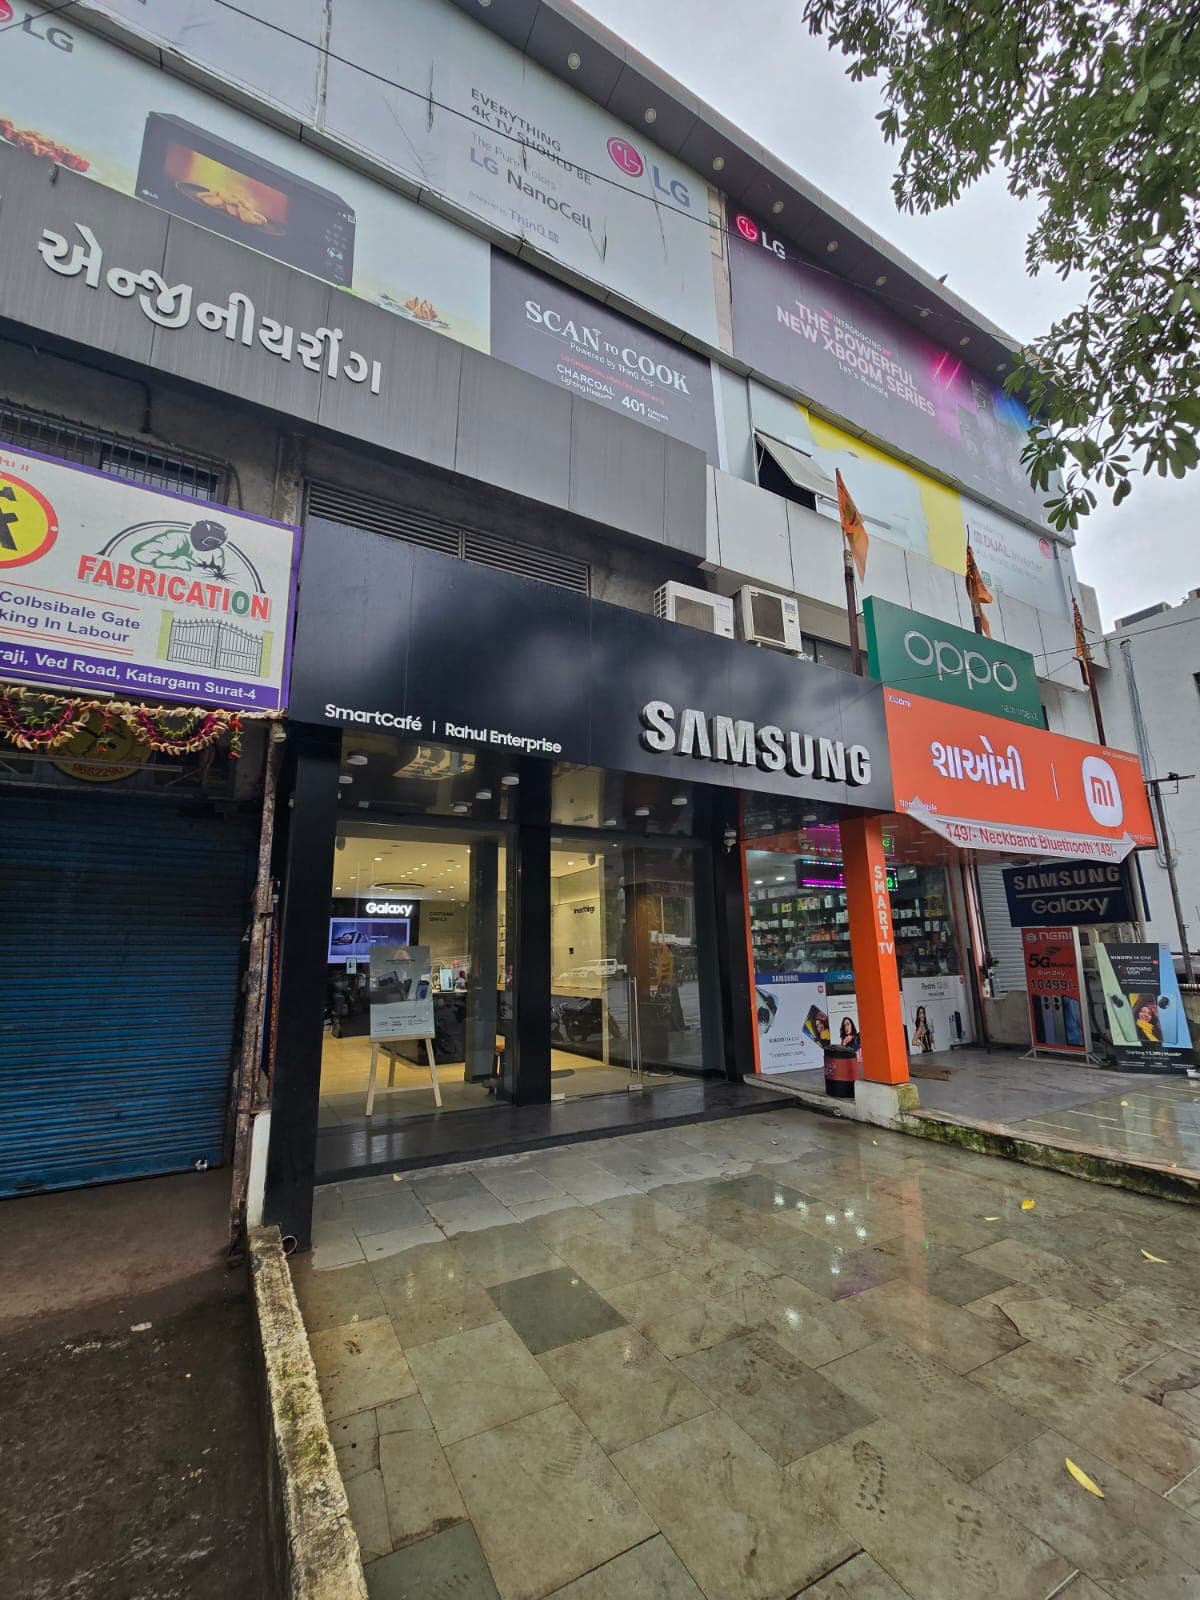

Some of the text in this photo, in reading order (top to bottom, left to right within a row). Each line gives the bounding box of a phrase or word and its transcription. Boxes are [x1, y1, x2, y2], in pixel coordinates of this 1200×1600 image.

[22, 13, 75, 53] LG
[471, 88, 562, 152] EVERYTHING
[471, 104, 592, 184] 4K TV SHOULD BE
[472, 133, 492, 151] The
[495, 146, 521, 167] Pure
[470, 146, 499, 175] LG
[507, 169, 592, 232] NanoCell
[652, 165, 690, 208] LG
[509, 207, 546, 238] ThinQ
[761, 230, 786, 260] LG
[525, 300, 599, 352] SCAN
[603, 341, 618, 356] TO
[622, 348, 691, 396] COOK
[570, 343, 605, 365] Powered
[607, 358, 616, 370] by
[776, 305, 935, 417] NEW XBOOM SERIES
[796, 300, 917, 390] THE POWERFUL
[557, 364, 614, 396] CHARCOAL
[622, 397, 645, 415] 401
[77, 555, 268, 620] FABRICATION
[0, 590, 140, 629] Colbsibale Gate
[44, 611, 60, 632] In
[67, 615, 130, 643] Labour
[35, 653, 68, 674] Ved
[72, 659, 120, 680] Road,
[126, 668, 200, 692] Katargam
[204, 681, 257, 700] Surat-4
[324, 703, 423, 732] SmartCafé
[445, 722, 487, 743] Rahul
[490, 730, 562, 756] Enterprise
[642, 700, 872, 788] SAMSUNG
[930, 734, 1026, 791] શાઓમી
[946, 823, 976, 842] 149/-
[979, 827, 1037, 848] Neckband
[1014, 866, 1120, 890] SAMSUNG
[366, 902, 412, 917] Galaxy
[873, 865, 894, 954] SMART TV
[1031, 898, 1109, 916] Galaxy
[772, 975, 798, 983] SAMSUNG
[1028, 953, 1050, 968] 5G
